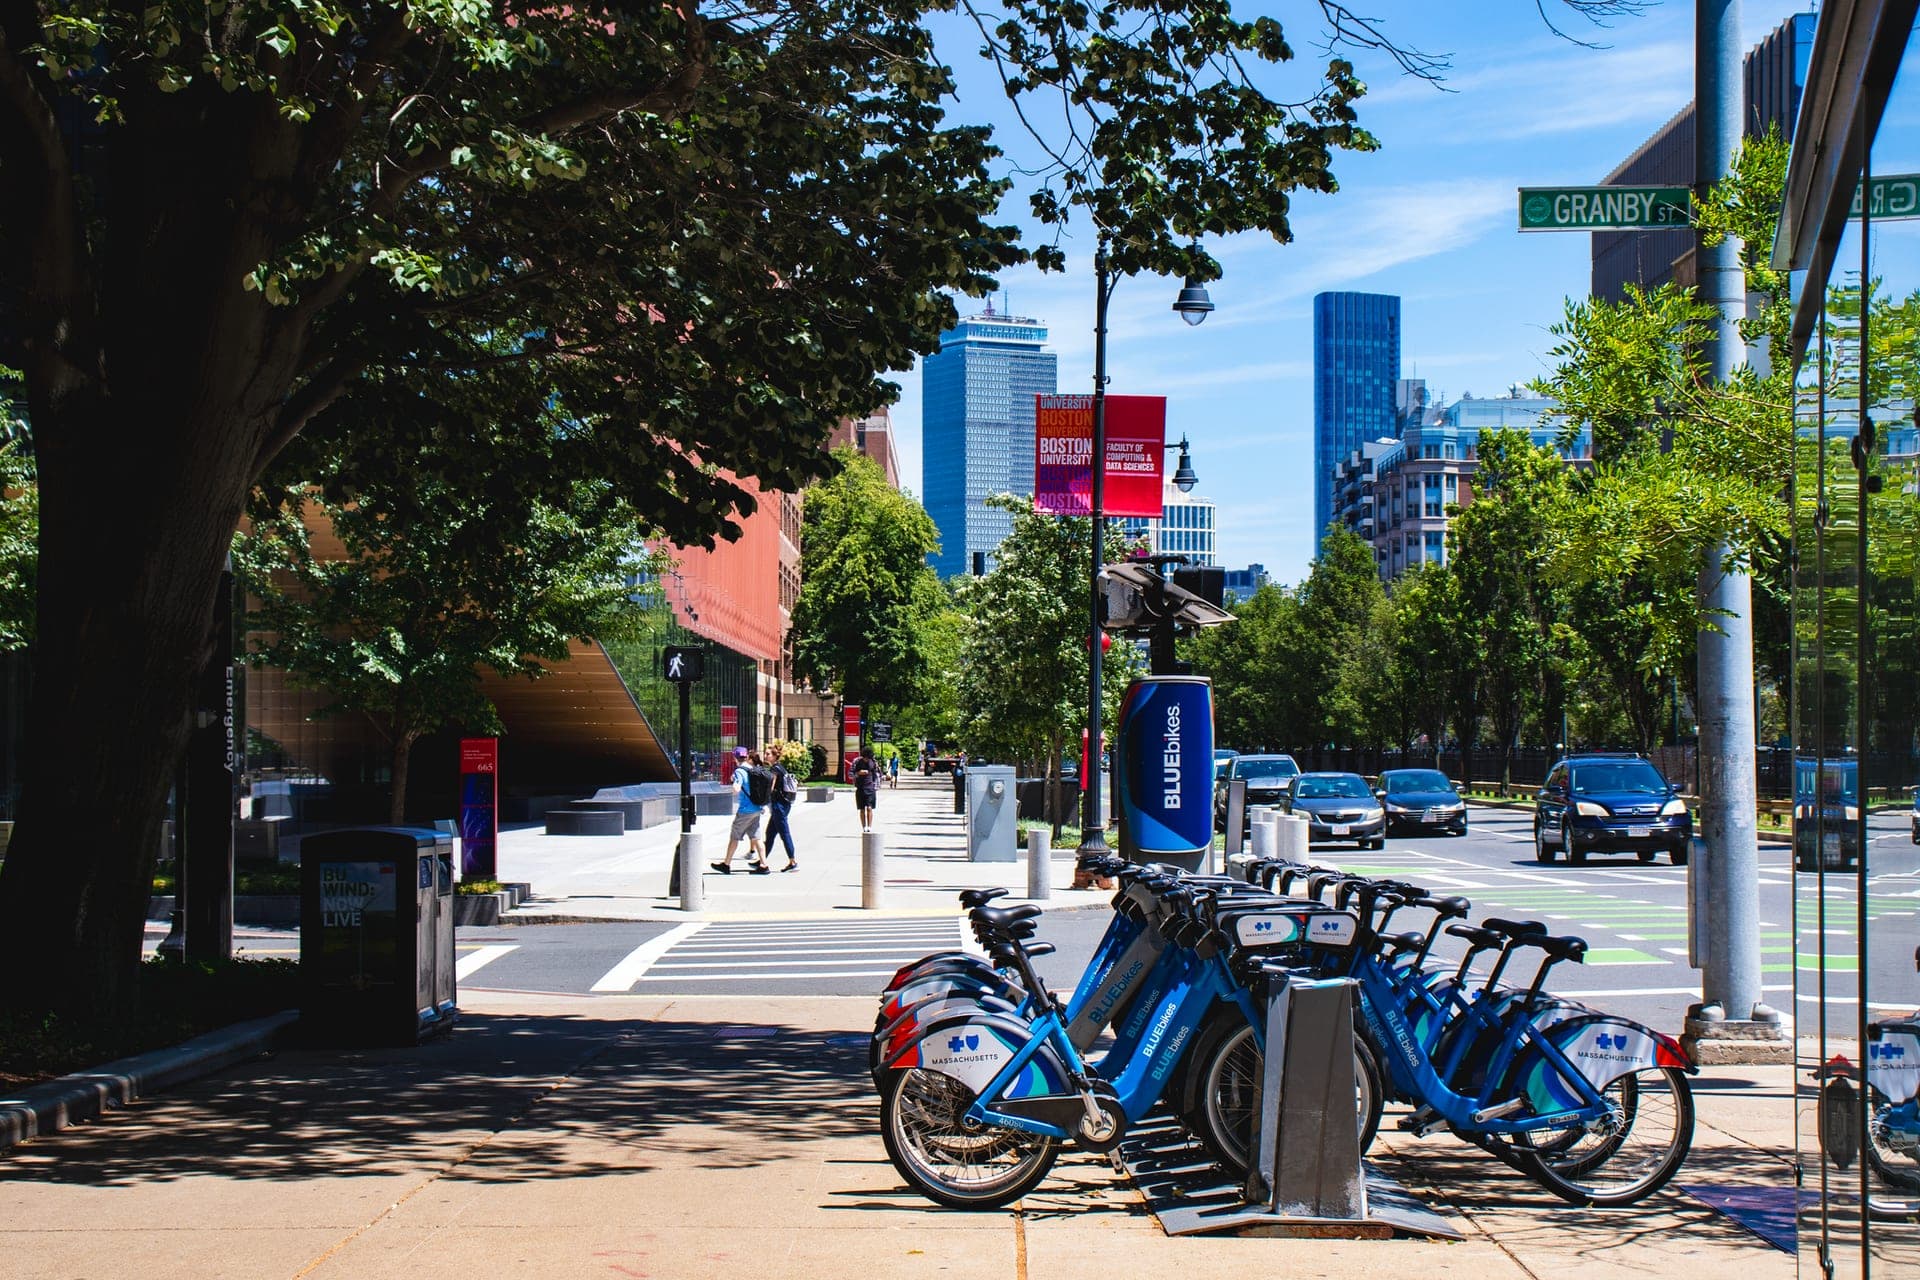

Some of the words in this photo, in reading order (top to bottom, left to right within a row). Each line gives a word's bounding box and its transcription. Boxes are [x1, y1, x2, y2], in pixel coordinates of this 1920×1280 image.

[1554, 193, 1656, 223] GRANBY
[1658, 207, 1674, 223] ST
[1041, 399, 1093, 410] UNIVERSITY
[1040, 410, 1093, 426] BOSTON
[1040, 437, 1093, 454] BOSTON
[1106, 443, 1134, 452] FACULTY
[1135, 444, 1144, 452] OF
[1040, 454, 1093, 465] UNIVERSITY
[1106, 453, 1144, 462] COMPUTING
[1146, 454, 1152, 462] &
[1105, 462, 1122, 470] DATA
[1123, 463, 1155, 471] SCIENCES
[1039, 492, 1091, 508] BOSTON
[224, 666, 233, 773] Emergency
[1164, 705, 1181, 809] BLUEbikes
[323, 868, 346, 881] BU
[323, 882, 375, 897] WIND:
[323, 897, 362, 910] NOW
[324, 911, 361, 927] LIVE
[1089, 960, 1144, 1023] BLUEbikes
[1126, 988, 1160, 1038] BLUEbikes
[1143, 1002, 1177, 1057] BLUEbikes
[1386, 1010, 1419, 1067] BLUEbikes
[932, 1054, 998, 1065] MASSACHUSETTS
[1152, 1025, 1189, 1080] BLUEbikes
[1577, 1051, 1643, 1063] MASSACHUSETTS
